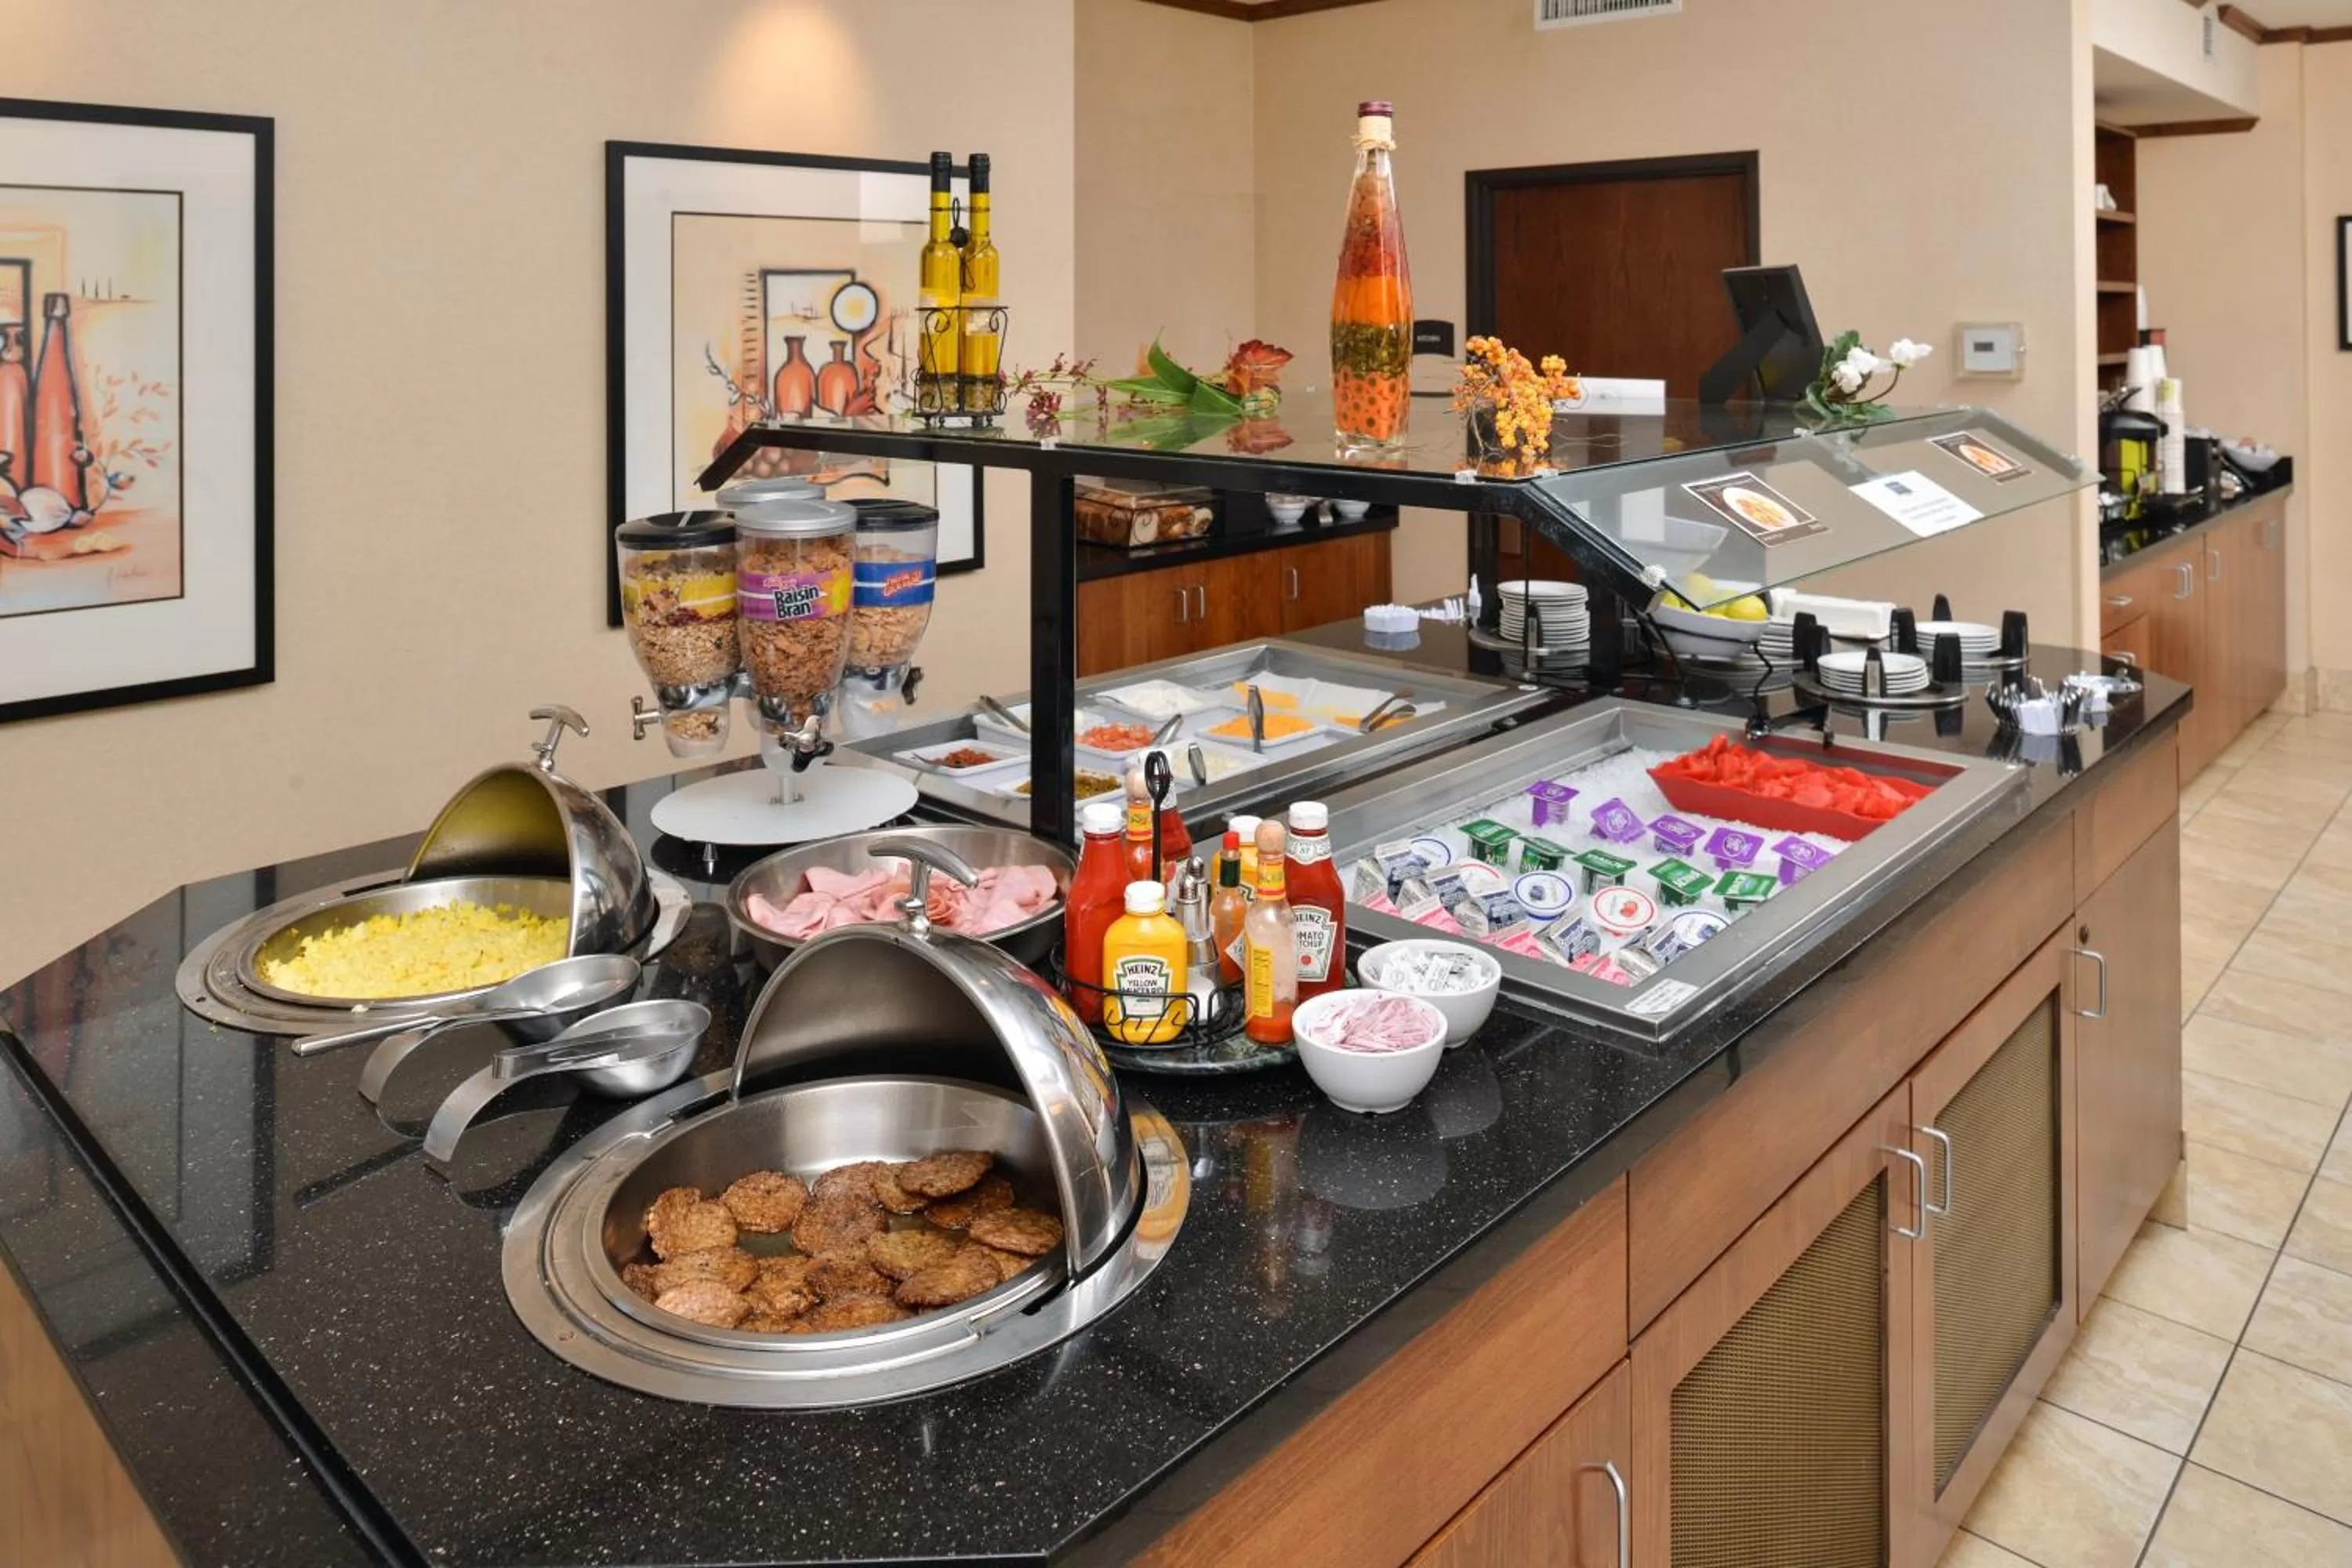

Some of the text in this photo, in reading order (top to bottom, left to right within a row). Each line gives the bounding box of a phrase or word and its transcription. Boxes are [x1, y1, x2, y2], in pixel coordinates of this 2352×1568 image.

[774, 586, 819, 604] Raisin
[776, 601, 811, 619] Bran
[1297, 931, 1324, 940] MATO
[1127, 964, 1158, 975] HEINZ
[1127, 978, 1158, 987] YELLOW
